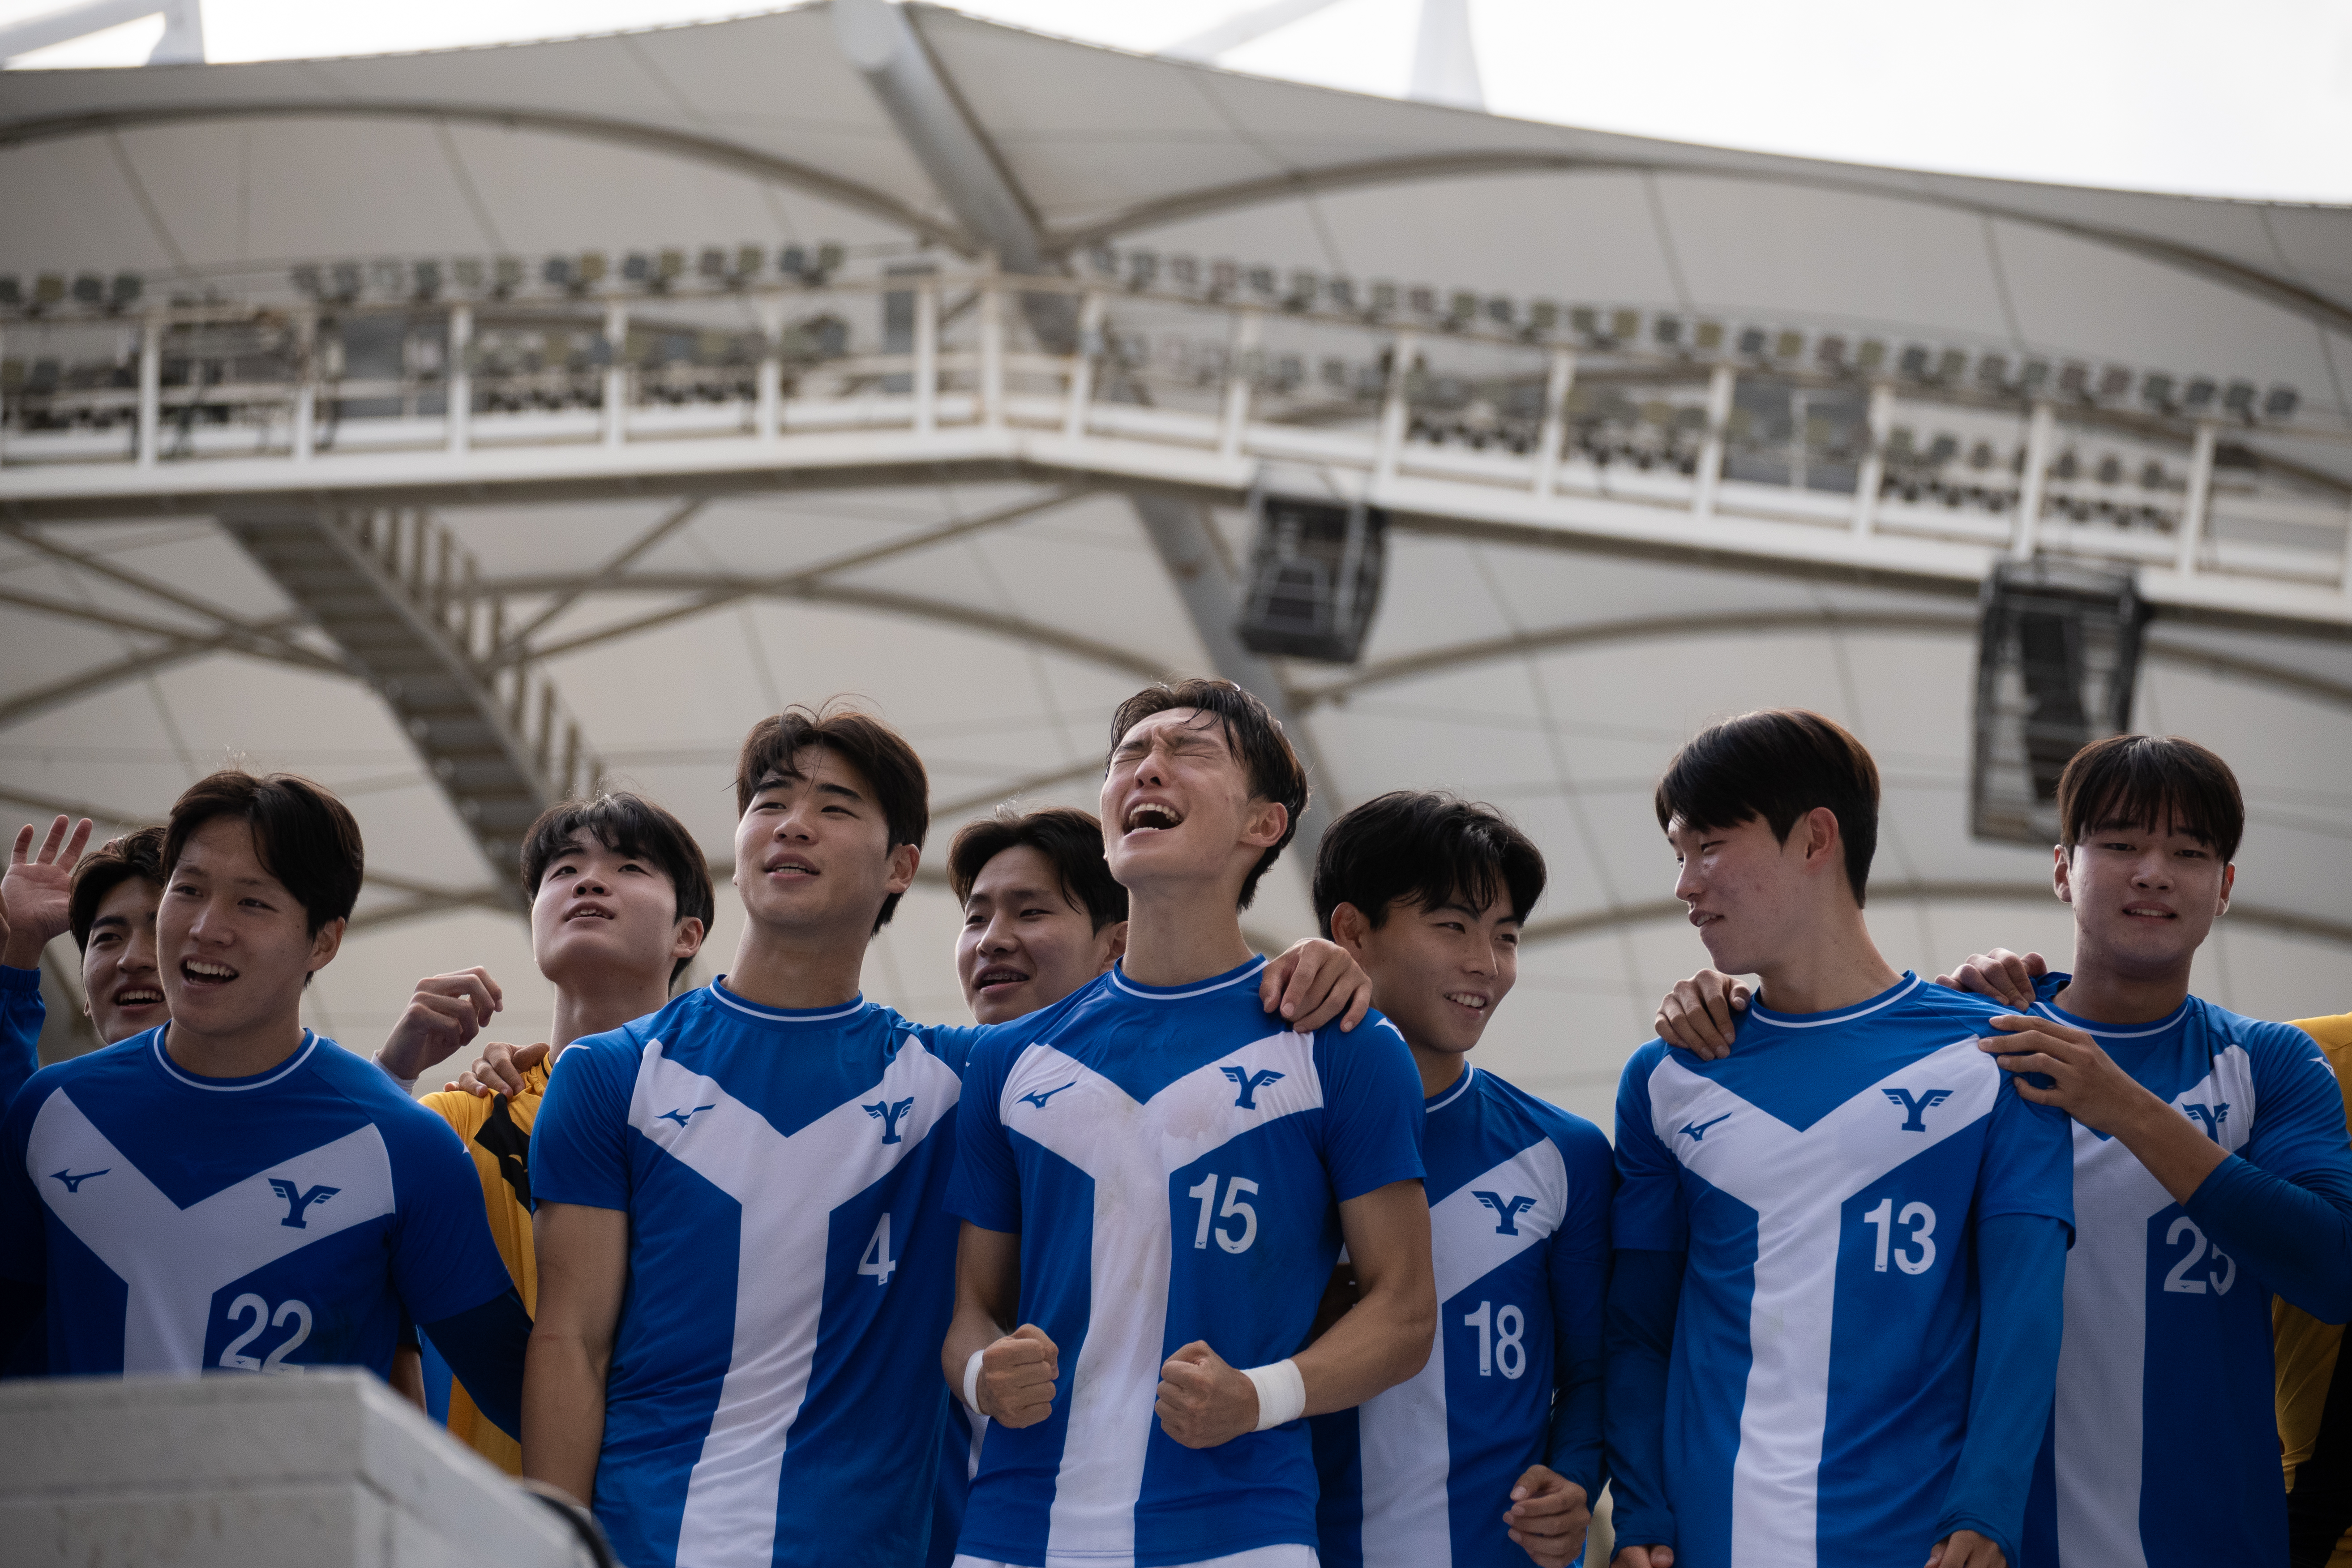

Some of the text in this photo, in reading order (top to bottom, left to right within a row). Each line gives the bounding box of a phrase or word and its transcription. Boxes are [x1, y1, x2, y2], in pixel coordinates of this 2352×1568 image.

[1219, 1065, 1287, 1110] Y
[1881, 1088, 1954, 1132] Y
[267, 1178, 342, 1229] Y
[1188, 1173, 1259, 1254] 15
[1470, 1191, 1538, 1236] Y
[1864, 1198, 1936, 1275] 13
[857, 1212, 896, 1286] 4
[2163, 1216, 2236, 1296] 25
[218, 1293, 313, 1375] 22
[1464, 1300, 1526, 1379] 18
